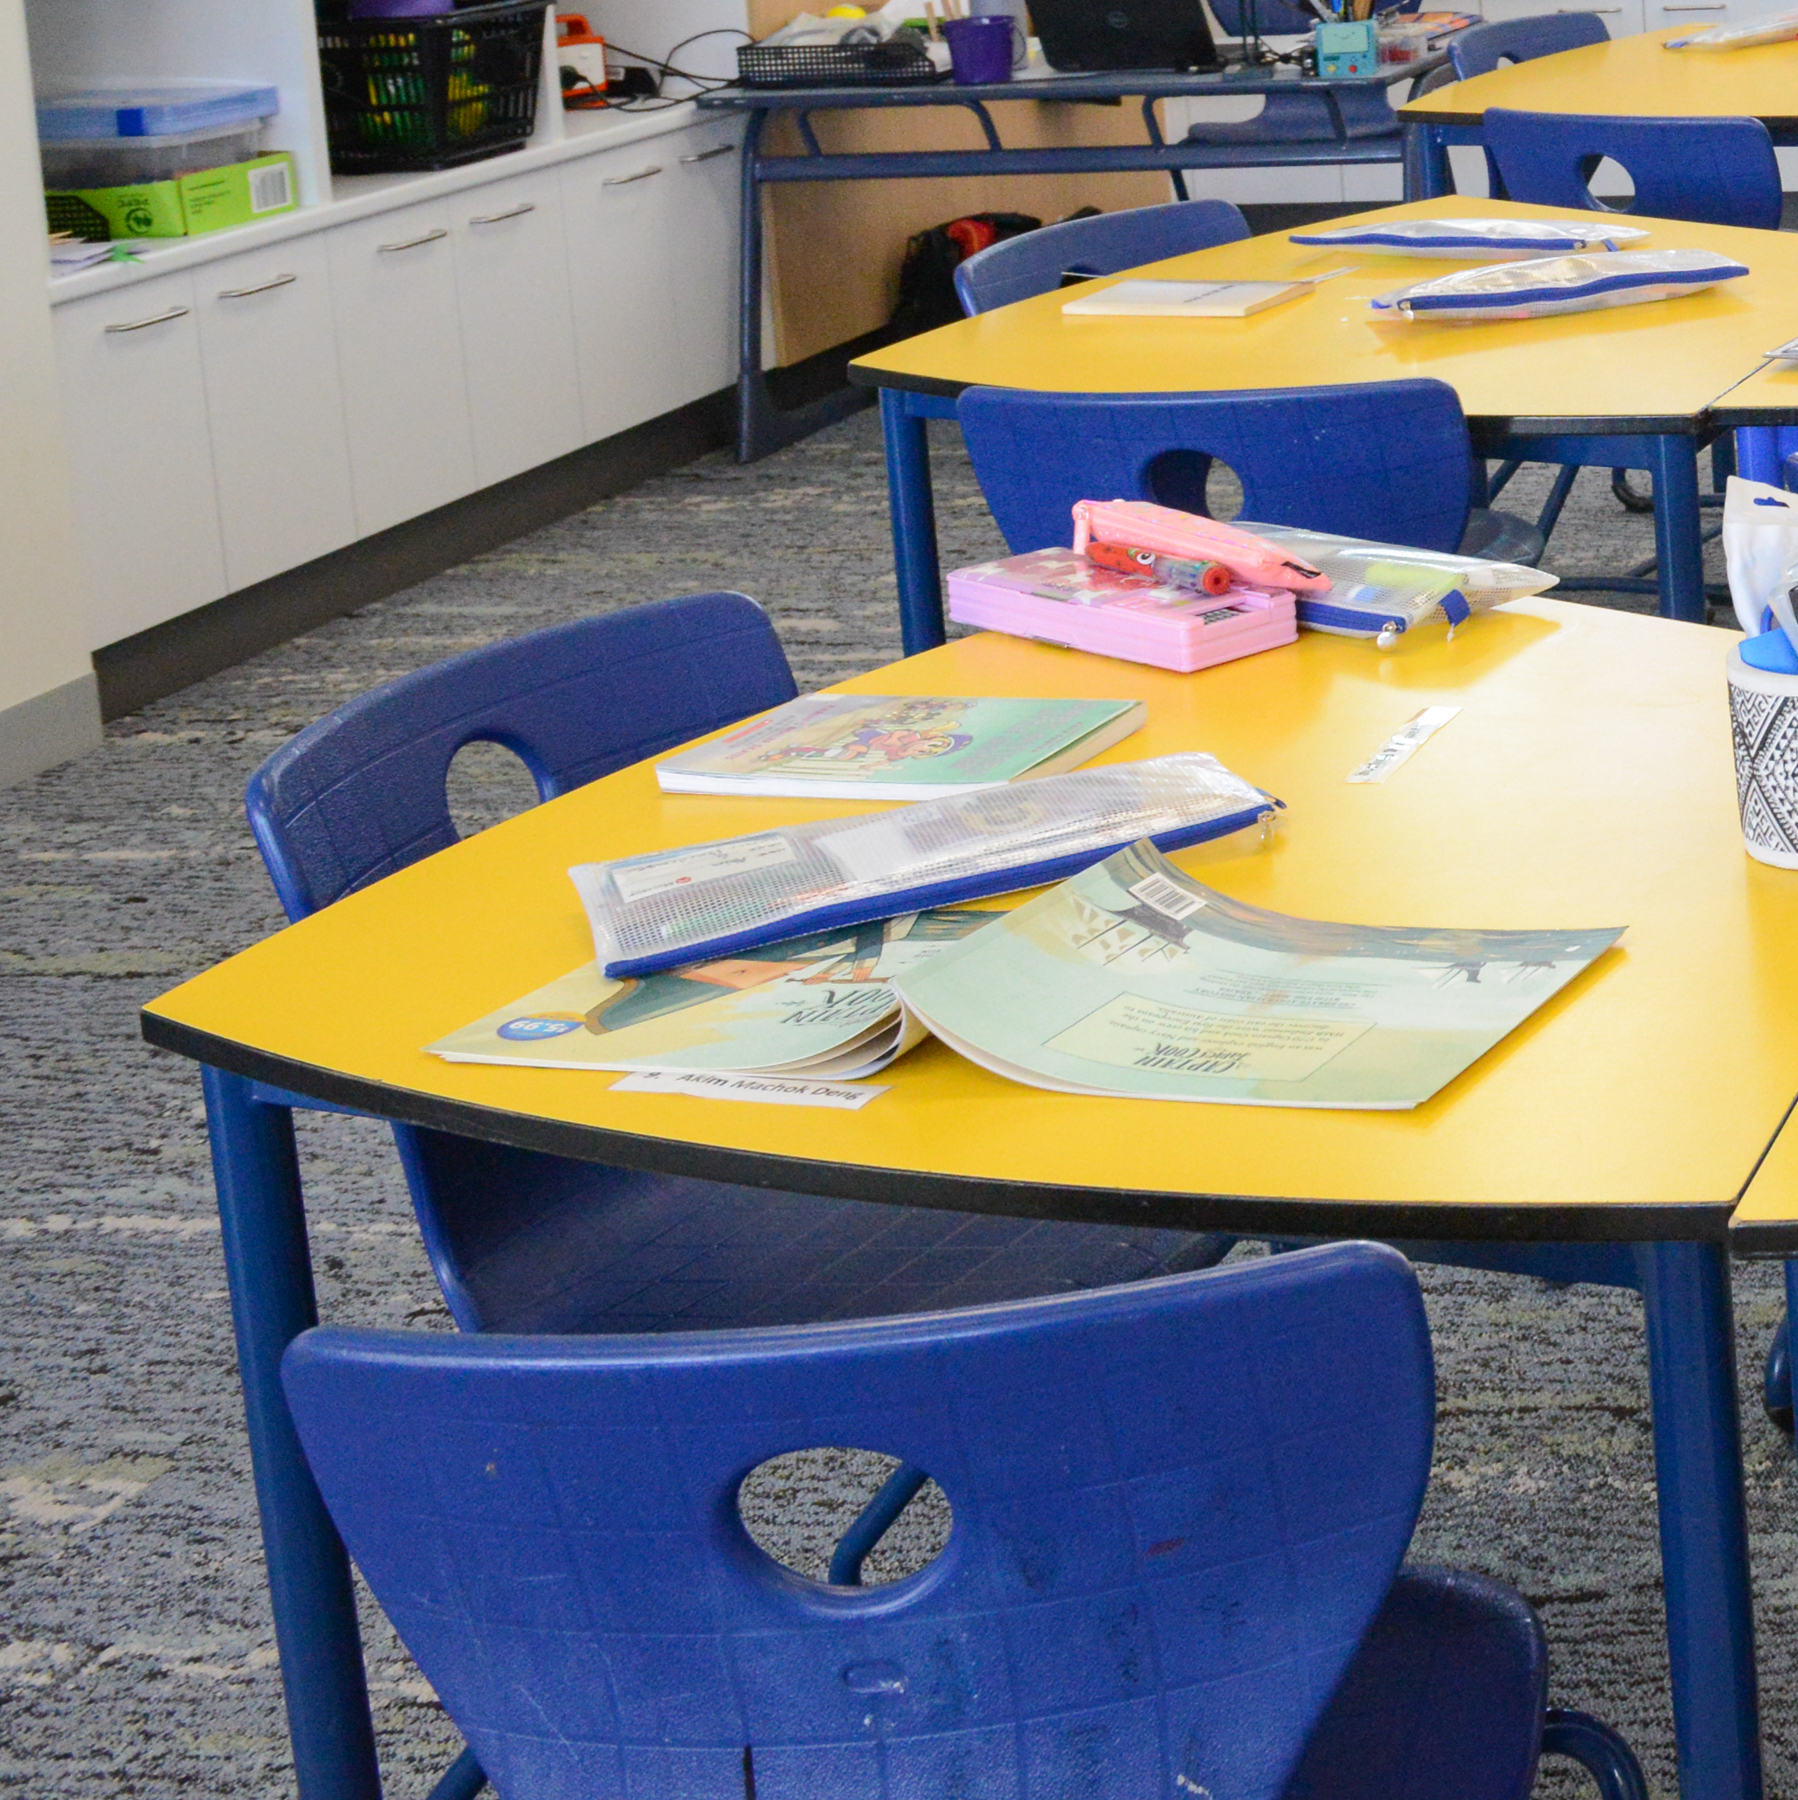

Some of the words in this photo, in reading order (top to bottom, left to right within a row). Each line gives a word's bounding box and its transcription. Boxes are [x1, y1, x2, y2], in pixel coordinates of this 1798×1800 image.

[508, 1020, 568, 1034] $5.99
[1133, 1056, 1237, 1074] CAPTAIN
[676, 1073, 728, 1087] Akim
[729, 1079, 809, 1094] Machok
[810, 1086, 865, 1101] Deng
